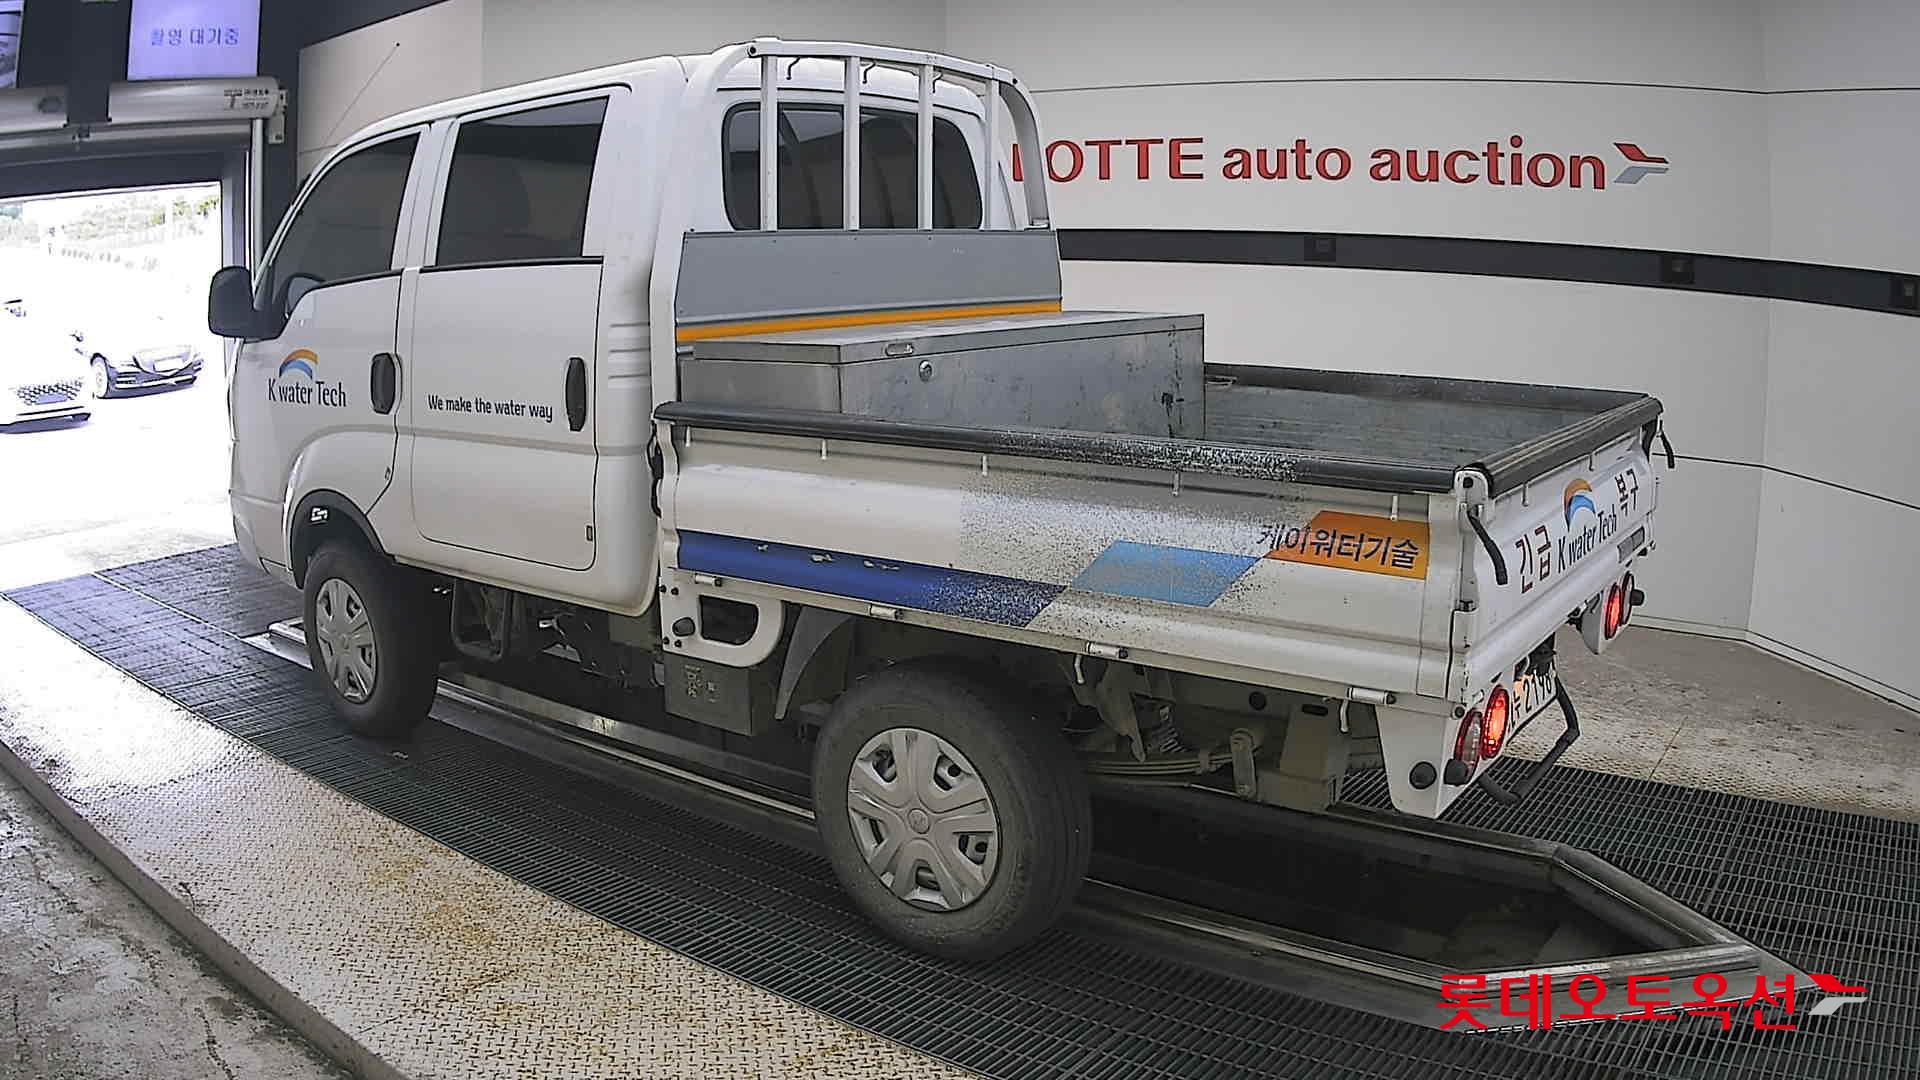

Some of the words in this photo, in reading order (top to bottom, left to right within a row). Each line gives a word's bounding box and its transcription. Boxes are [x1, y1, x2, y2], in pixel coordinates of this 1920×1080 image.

[190, 27, 239, 46] 대기중
[1222, 138, 1352, 181] auto
[1368, 135, 1606, 191] auction
[268, 378, 276, 401] K
[279, 381, 313, 404] water
[316, 381, 347, 407] Tech
[428, 394, 443, 411] We
[446, 396, 472, 413] make
[475, 397, 492, 414] the
[494, 400, 526, 416] water
[528, 405, 553, 424] way
[1614, 469, 1639, 517] 복구
[1257, 523, 1419, 570] 케이워터기술
[1514, 525, 1551, 593] 긴급
[1557, 536, 1567, 573] K
[1568, 525, 1597, 566] water
[1597, 504, 1617, 543] Tech
